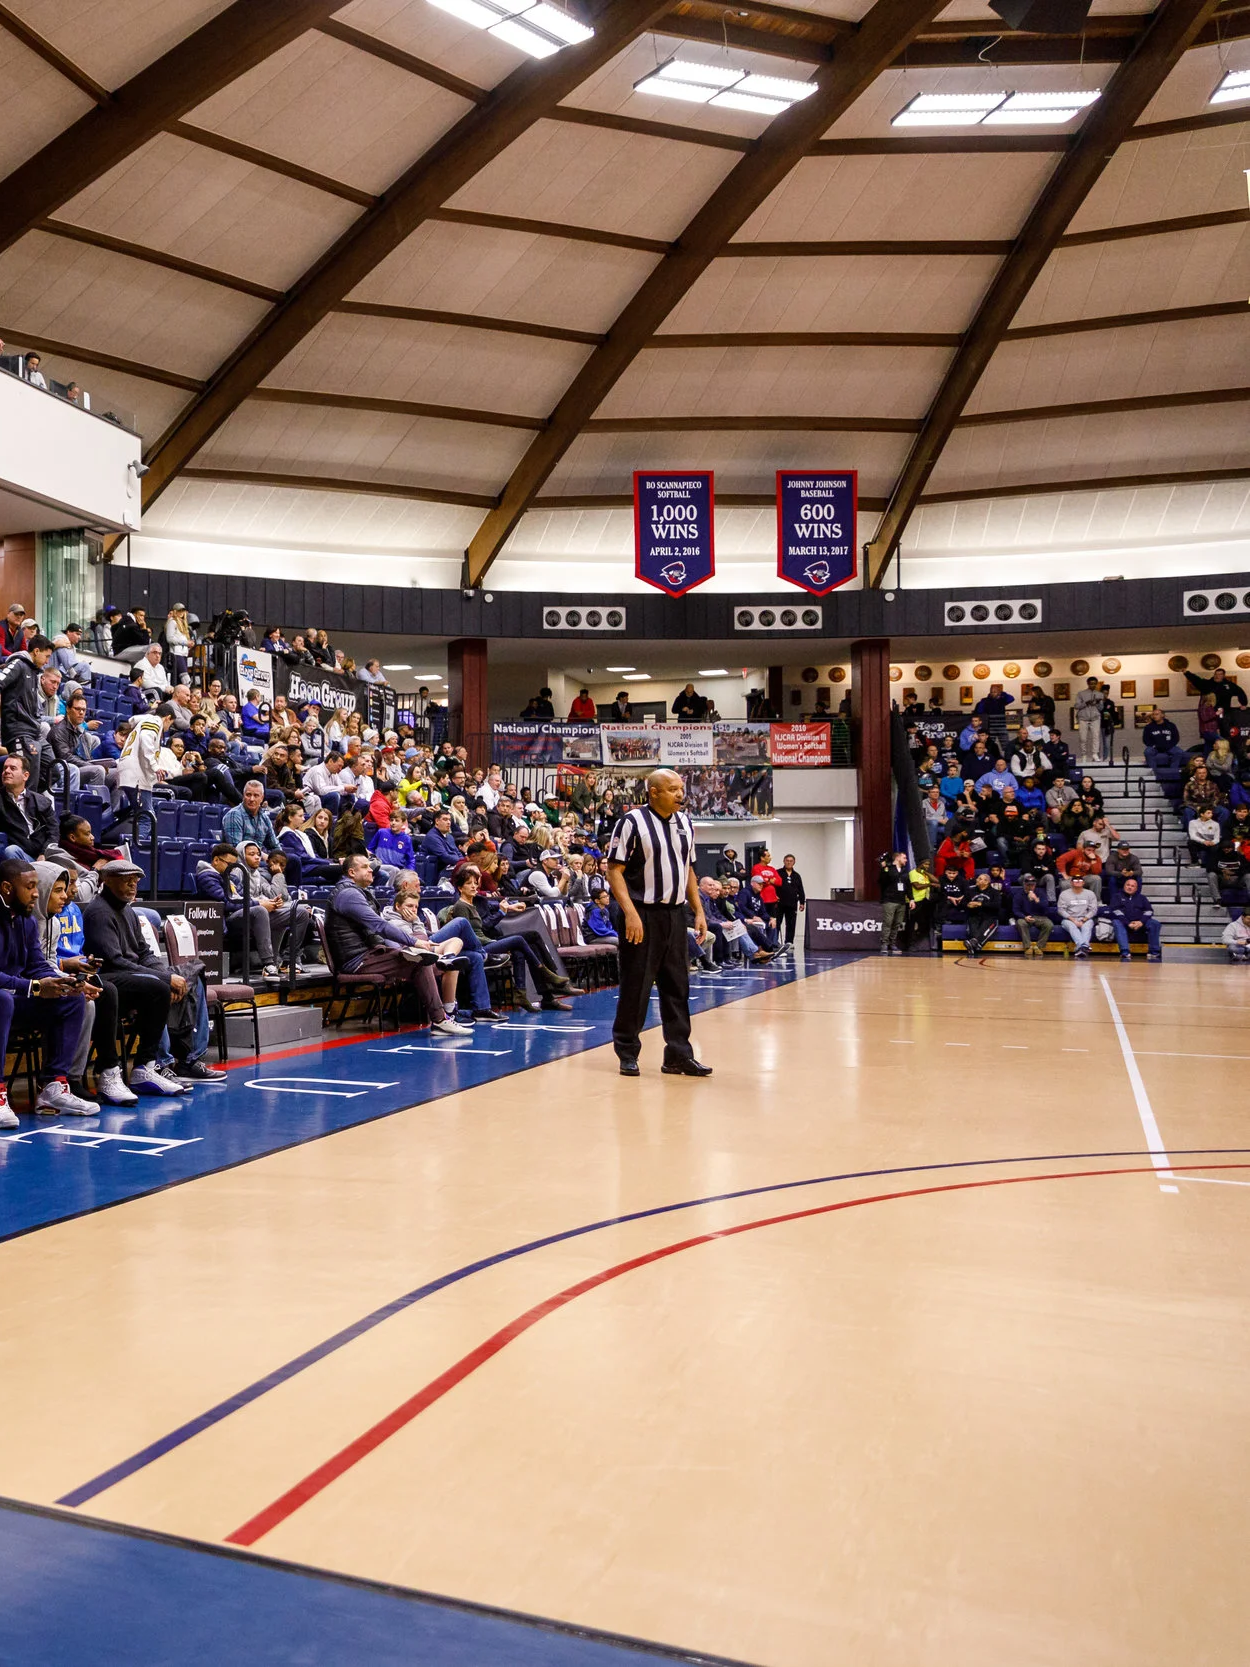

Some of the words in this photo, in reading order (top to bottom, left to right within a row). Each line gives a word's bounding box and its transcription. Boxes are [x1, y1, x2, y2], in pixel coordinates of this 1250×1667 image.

[646, 481, 656, 489] BO
[656, 481, 701, 489] SCANNAPIECO
[787, 480, 814, 489] JOHNNY
[815, 480, 846, 489] JOHNSON
[657, 490, 690, 498] SOFTBALL
[800, 489, 834, 498] BASEBALL
[651, 504, 697, 524] 1,000
[800, 503, 835, 520] 600
[651, 523, 699, 539] WINS
[794, 523, 842, 539] WINS
[650, 547, 673, 556] APRIL
[673, 547, 681, 557] 2,
[682, 547, 700, 556] 2016
[788, 546, 817, 556] MARCH
[818, 546, 829, 557] 13,
[829, 546, 848, 556] 2017
[493, 723, 538, 734] National
[541, 724, 600, 736] Champions
[601, 723, 648, 731] National
[651, 723, 712, 732] Champions
[791, 724, 807, 732] 2010
[914, 721, 944, 731] Hoop
[774, 733, 795, 741] NJCAA
[796, 733, 820, 741] Division
[922, 730, 957, 739] Group
[776, 742, 803, 750] Women's
[803, 742, 827, 750] Softball
[772, 752, 797, 763] National
[798, 752, 831, 765] Champions
[188, 906, 208, 919] Follow
